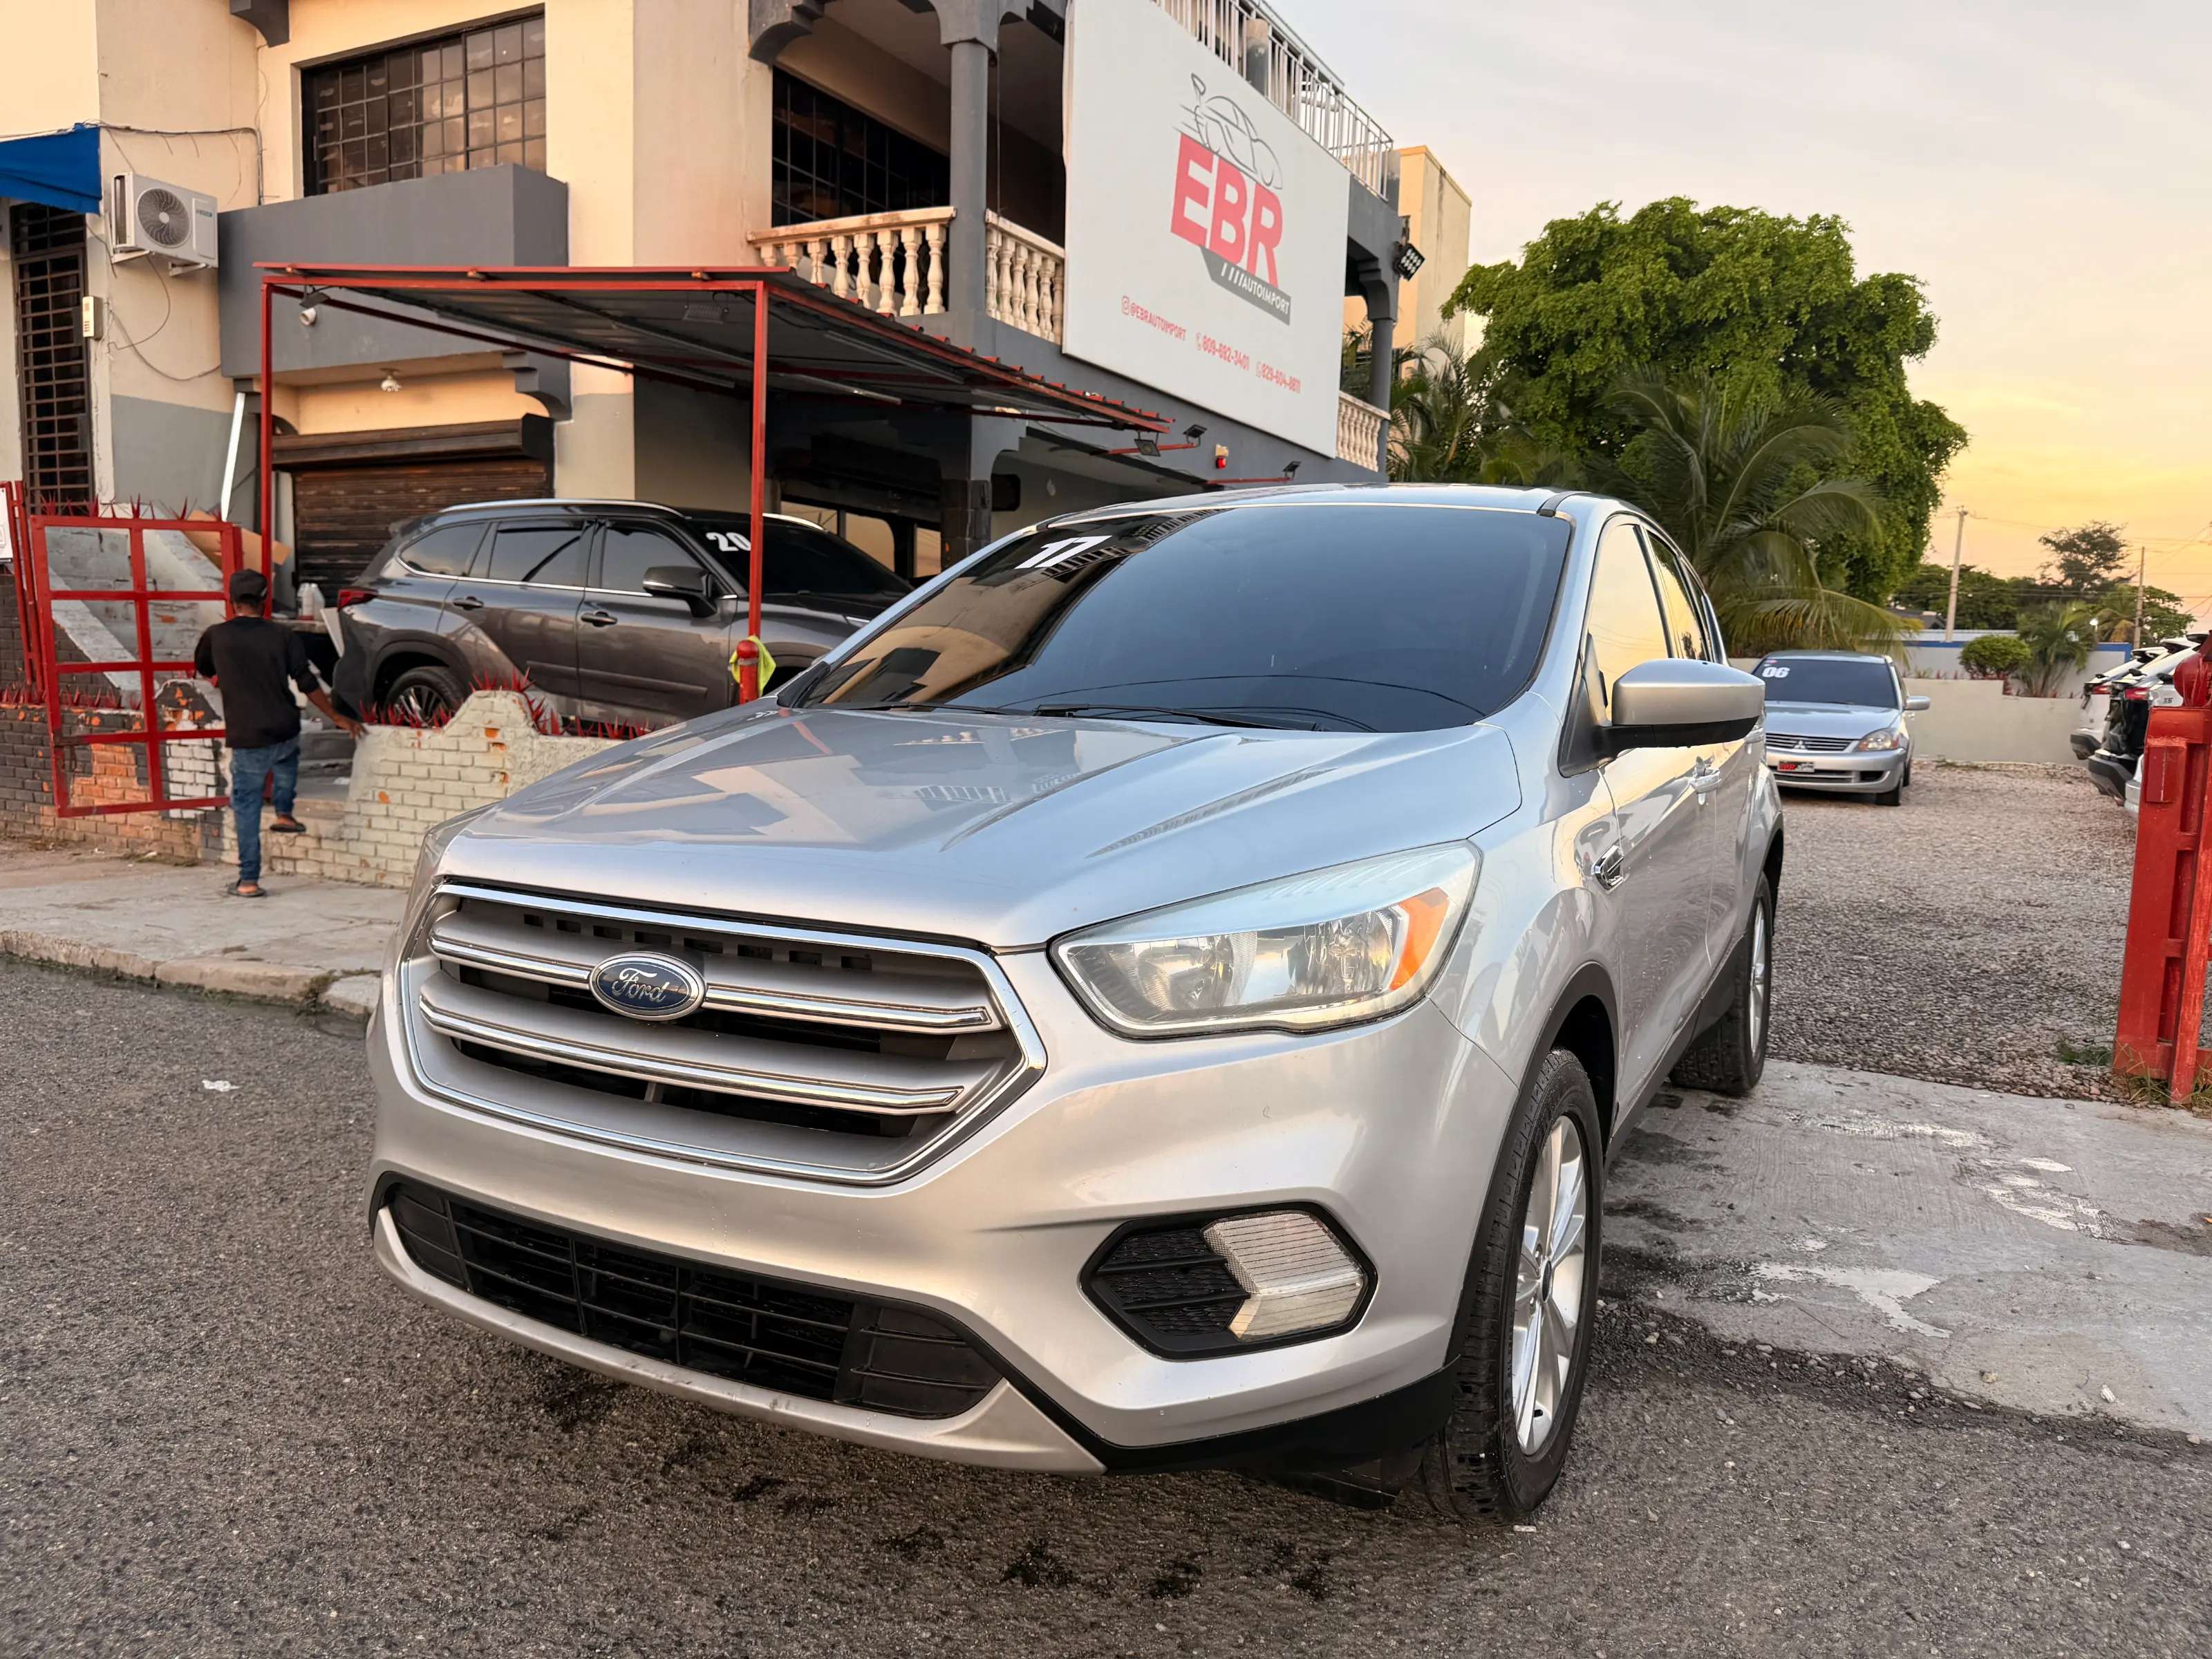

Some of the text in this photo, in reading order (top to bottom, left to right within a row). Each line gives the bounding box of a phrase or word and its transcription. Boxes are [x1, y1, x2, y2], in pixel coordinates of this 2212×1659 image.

[1170, 133, 1283, 288] EBR
[1241, 276, 1290, 315] AUTOIMPORT
[705, 532, 751, 552] 20
[1014, 535, 1112, 570] 17
[1762, 666, 1790, 677] 06
[611, 967, 670, 1002] Ford
